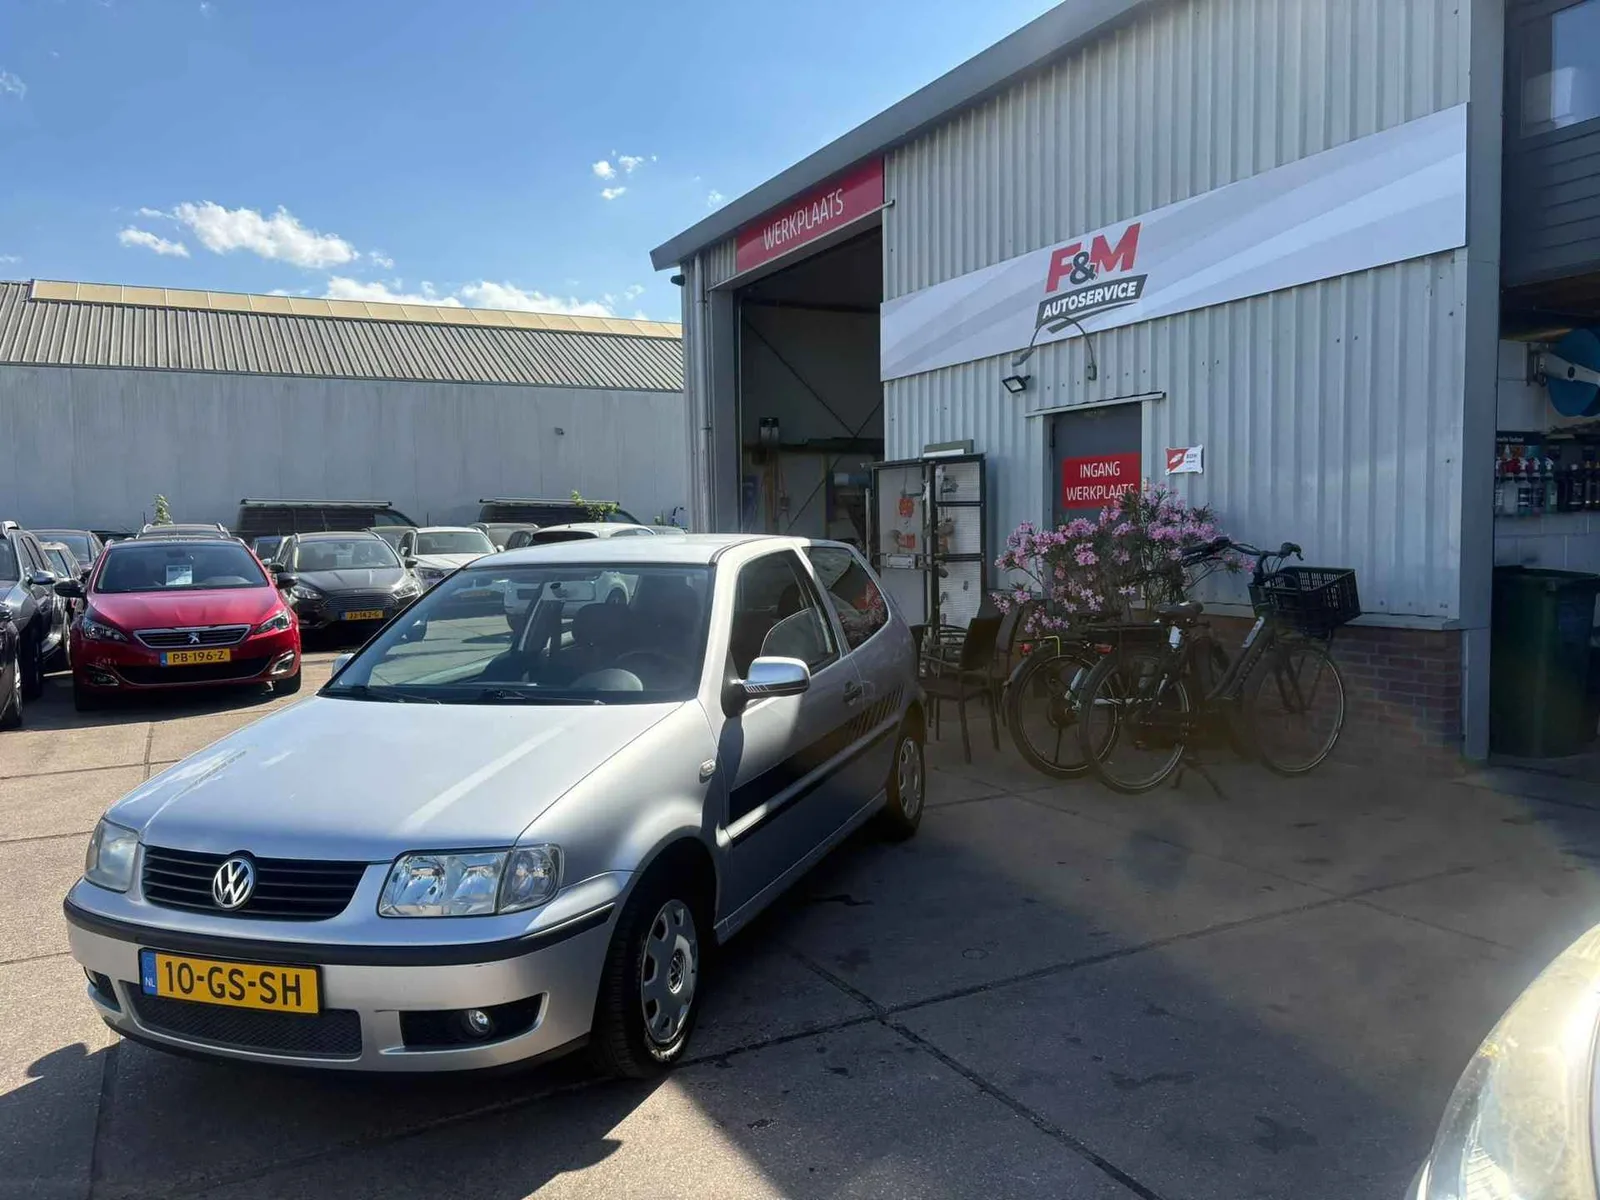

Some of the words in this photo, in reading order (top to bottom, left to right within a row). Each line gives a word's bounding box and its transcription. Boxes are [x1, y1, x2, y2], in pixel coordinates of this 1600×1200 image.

[763, 188, 844, 251] WERKPLAATS
[1045, 221, 1141, 294] F&M
[1042, 281, 1138, 320] AUTOSERVICE
[1080, 461, 1121, 479] INGANG
[172, 650, 226, 663] PB-196-Z
[144, 976, 156, 988] NL
[165, 961, 302, 1007] 10-GS-SH
